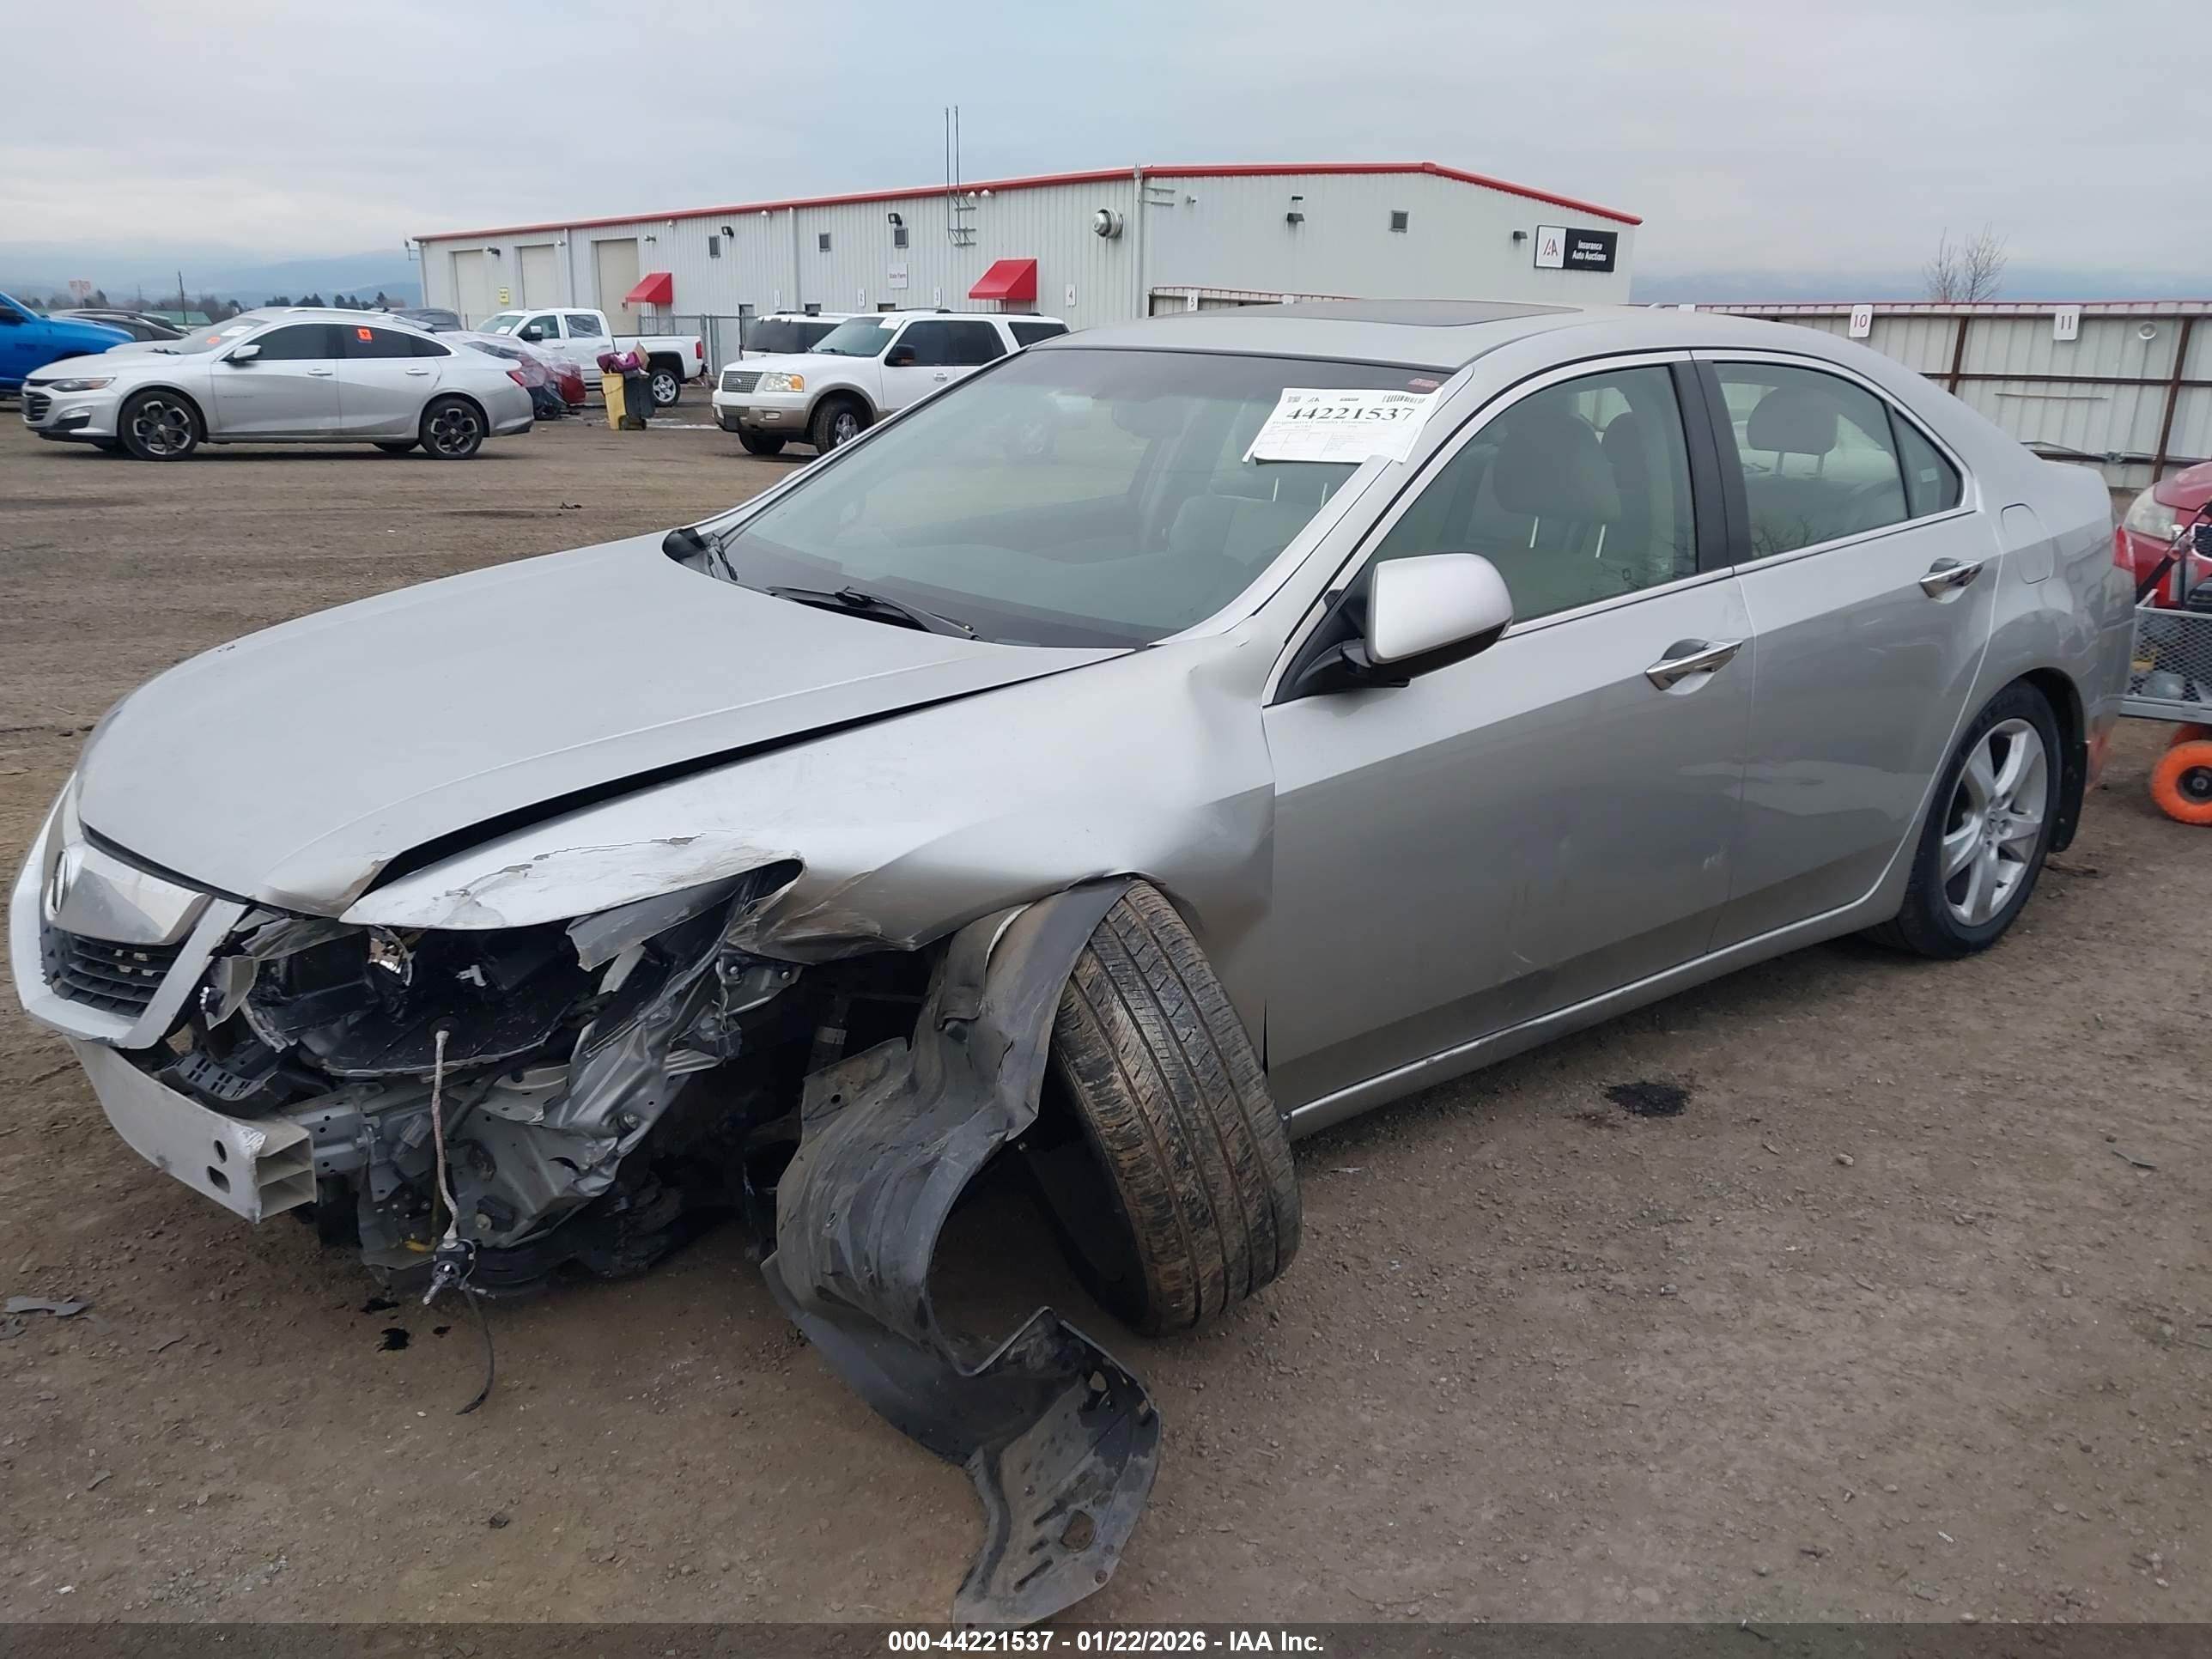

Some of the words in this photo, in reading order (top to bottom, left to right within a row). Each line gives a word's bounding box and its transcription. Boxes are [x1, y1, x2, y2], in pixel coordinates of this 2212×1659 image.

[1577, 240, 1602, 250] Insurance
[1572, 250, 1585, 260] Auto
[1585, 251, 1607, 262] Auctions
[1068, 290, 1073, 299] 4
[1190, 295, 1194, 307] 5
[1854, 314, 1868, 328] 10
[2061, 315, 2072, 330] 11
[1286, 407, 1415, 421] 44221537
